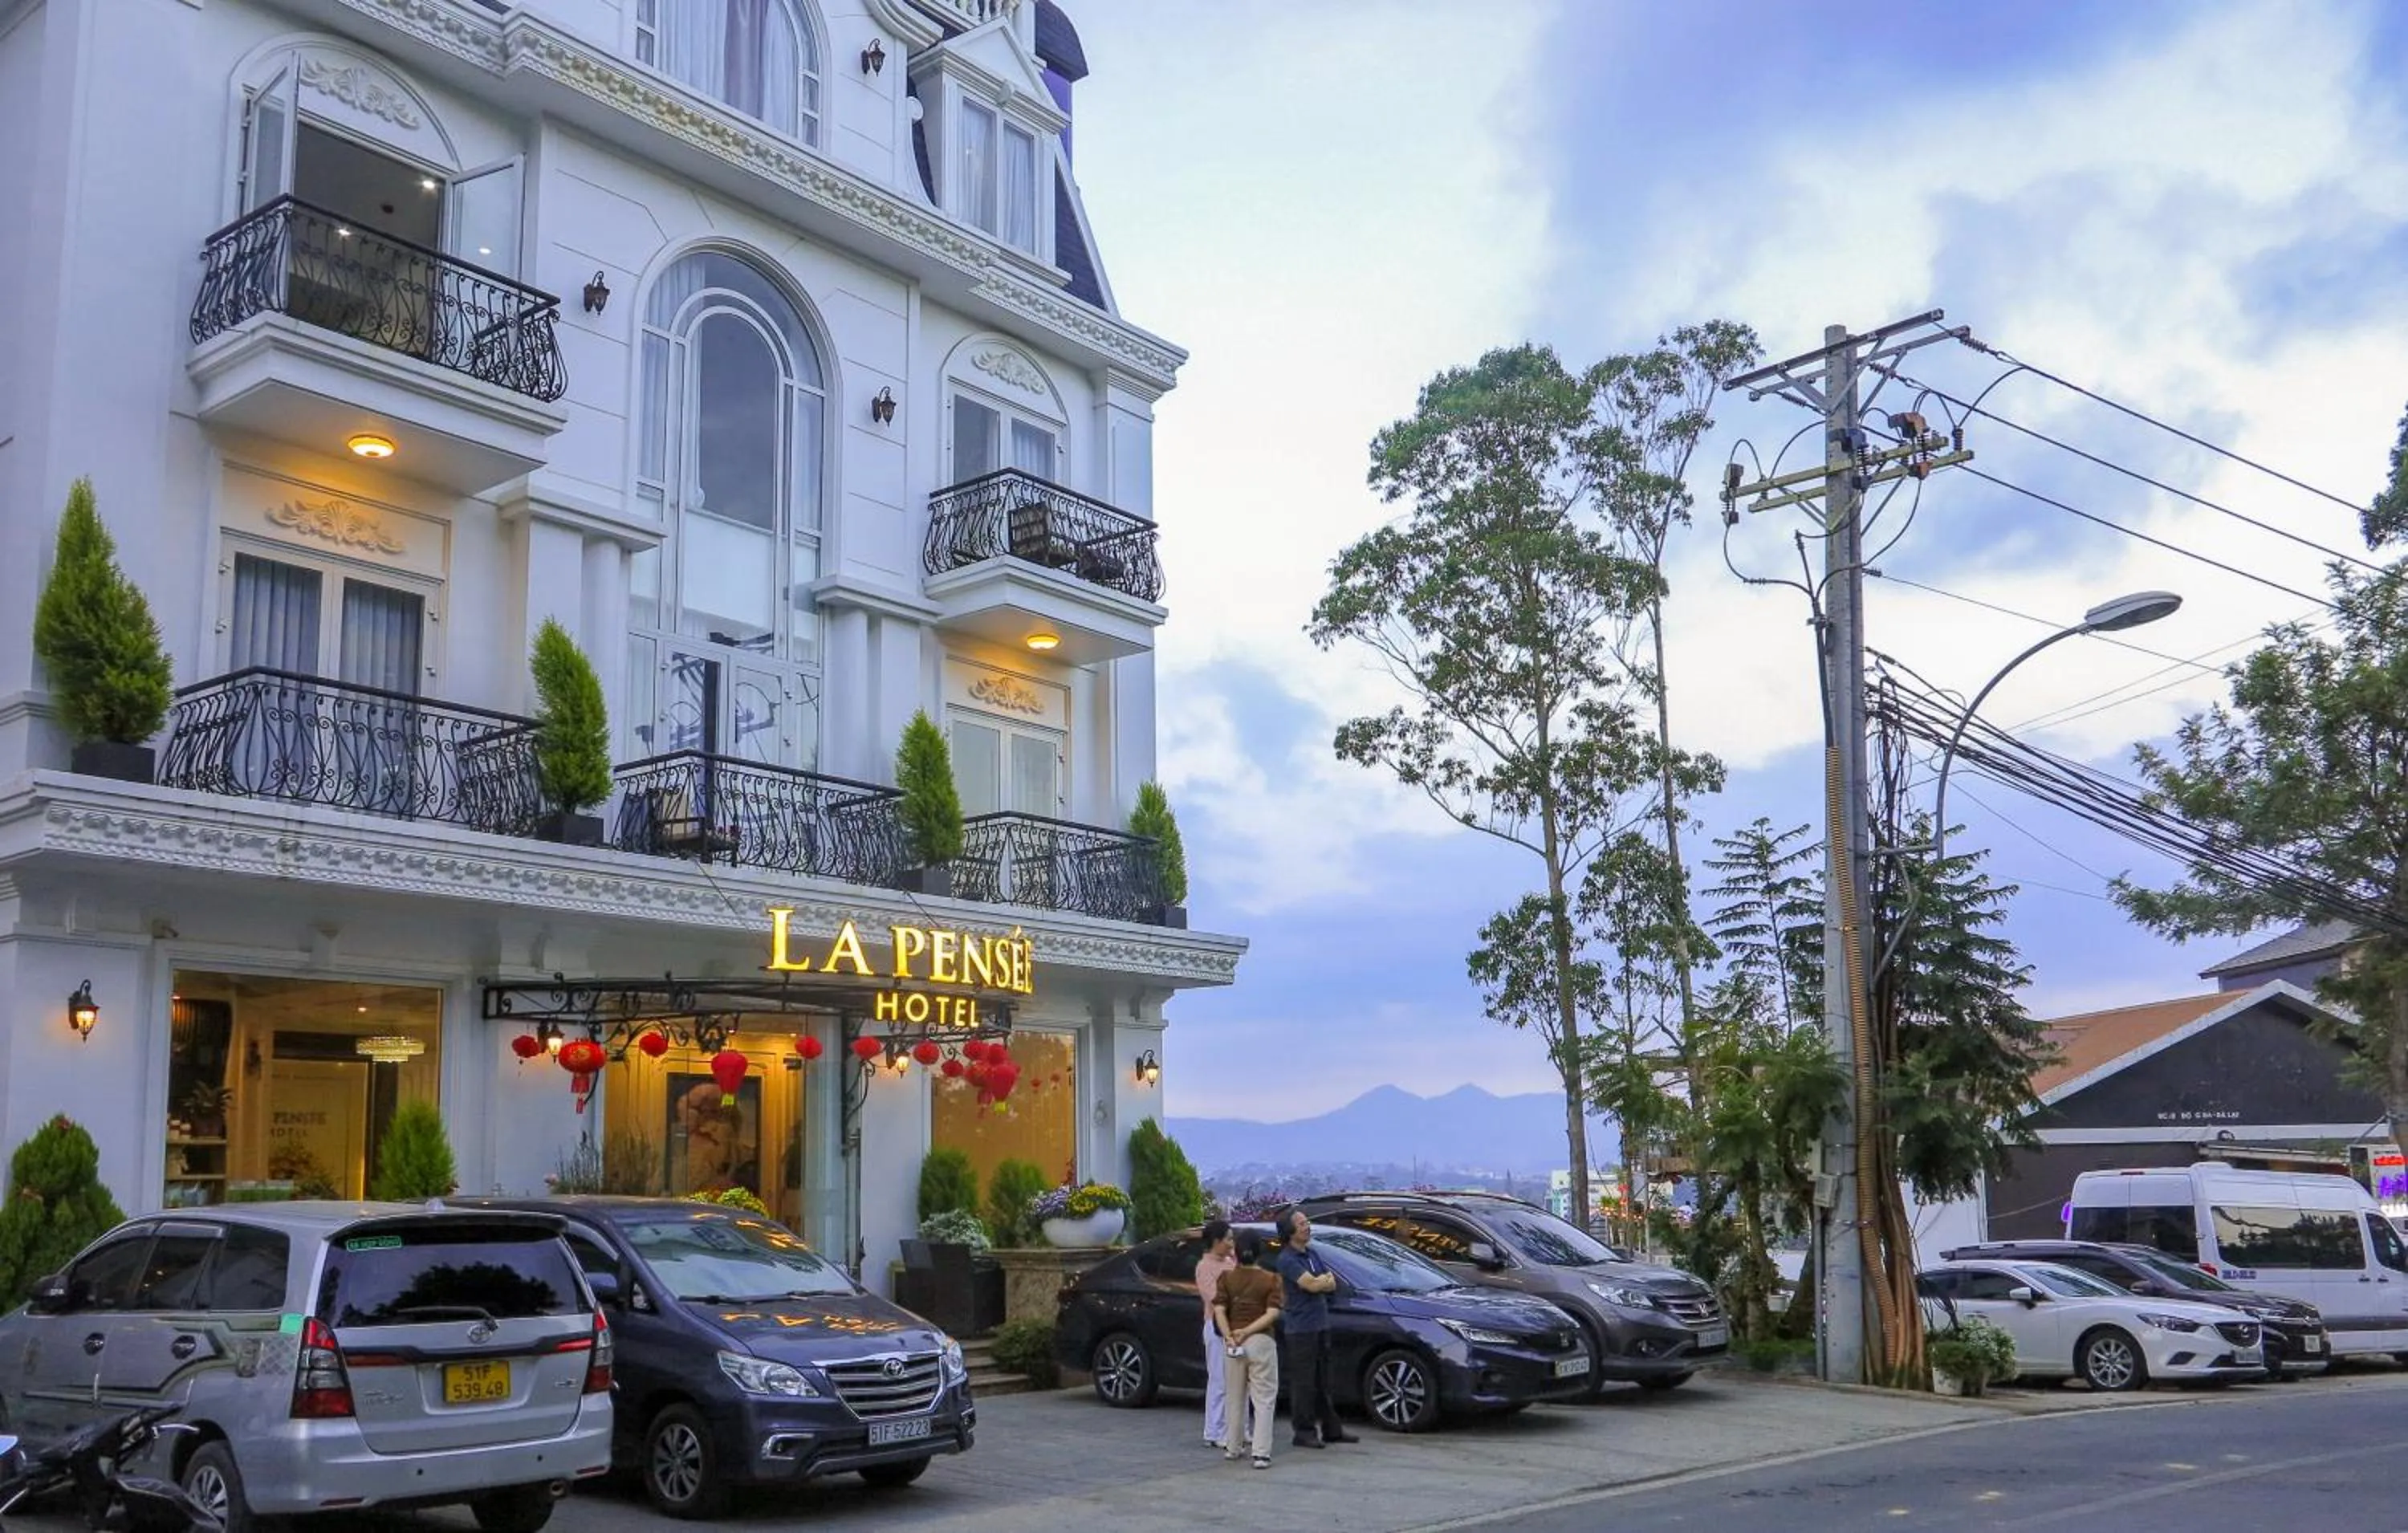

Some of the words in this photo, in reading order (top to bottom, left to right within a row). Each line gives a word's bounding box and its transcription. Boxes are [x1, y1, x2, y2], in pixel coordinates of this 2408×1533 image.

[890, 925, 1034, 994] PENSÉE
[876, 990, 980, 1028] HOTEL
[463, 1364, 491, 1381] 51F
